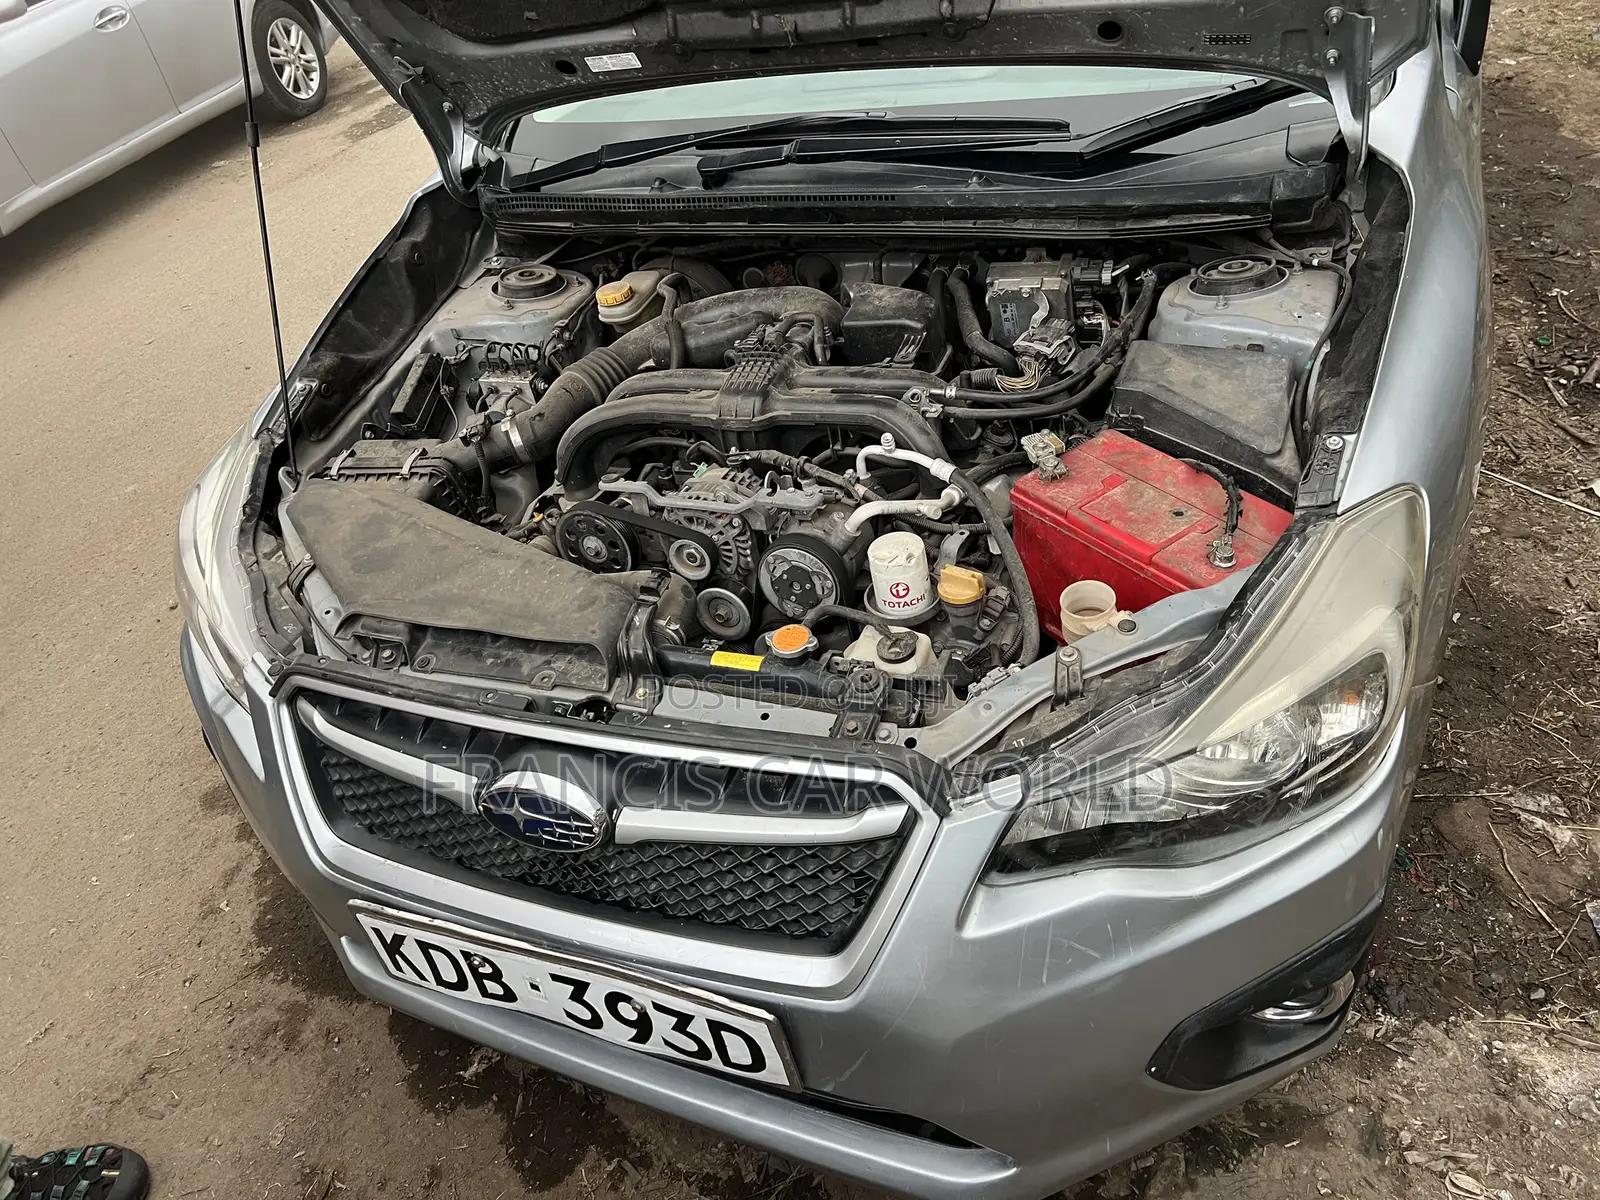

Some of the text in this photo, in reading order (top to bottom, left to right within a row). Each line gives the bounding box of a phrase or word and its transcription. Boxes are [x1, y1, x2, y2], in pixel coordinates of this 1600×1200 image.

[881, 593, 926, 609] TOTACHI
[370, 926, 768, 1074] KDB 393D
